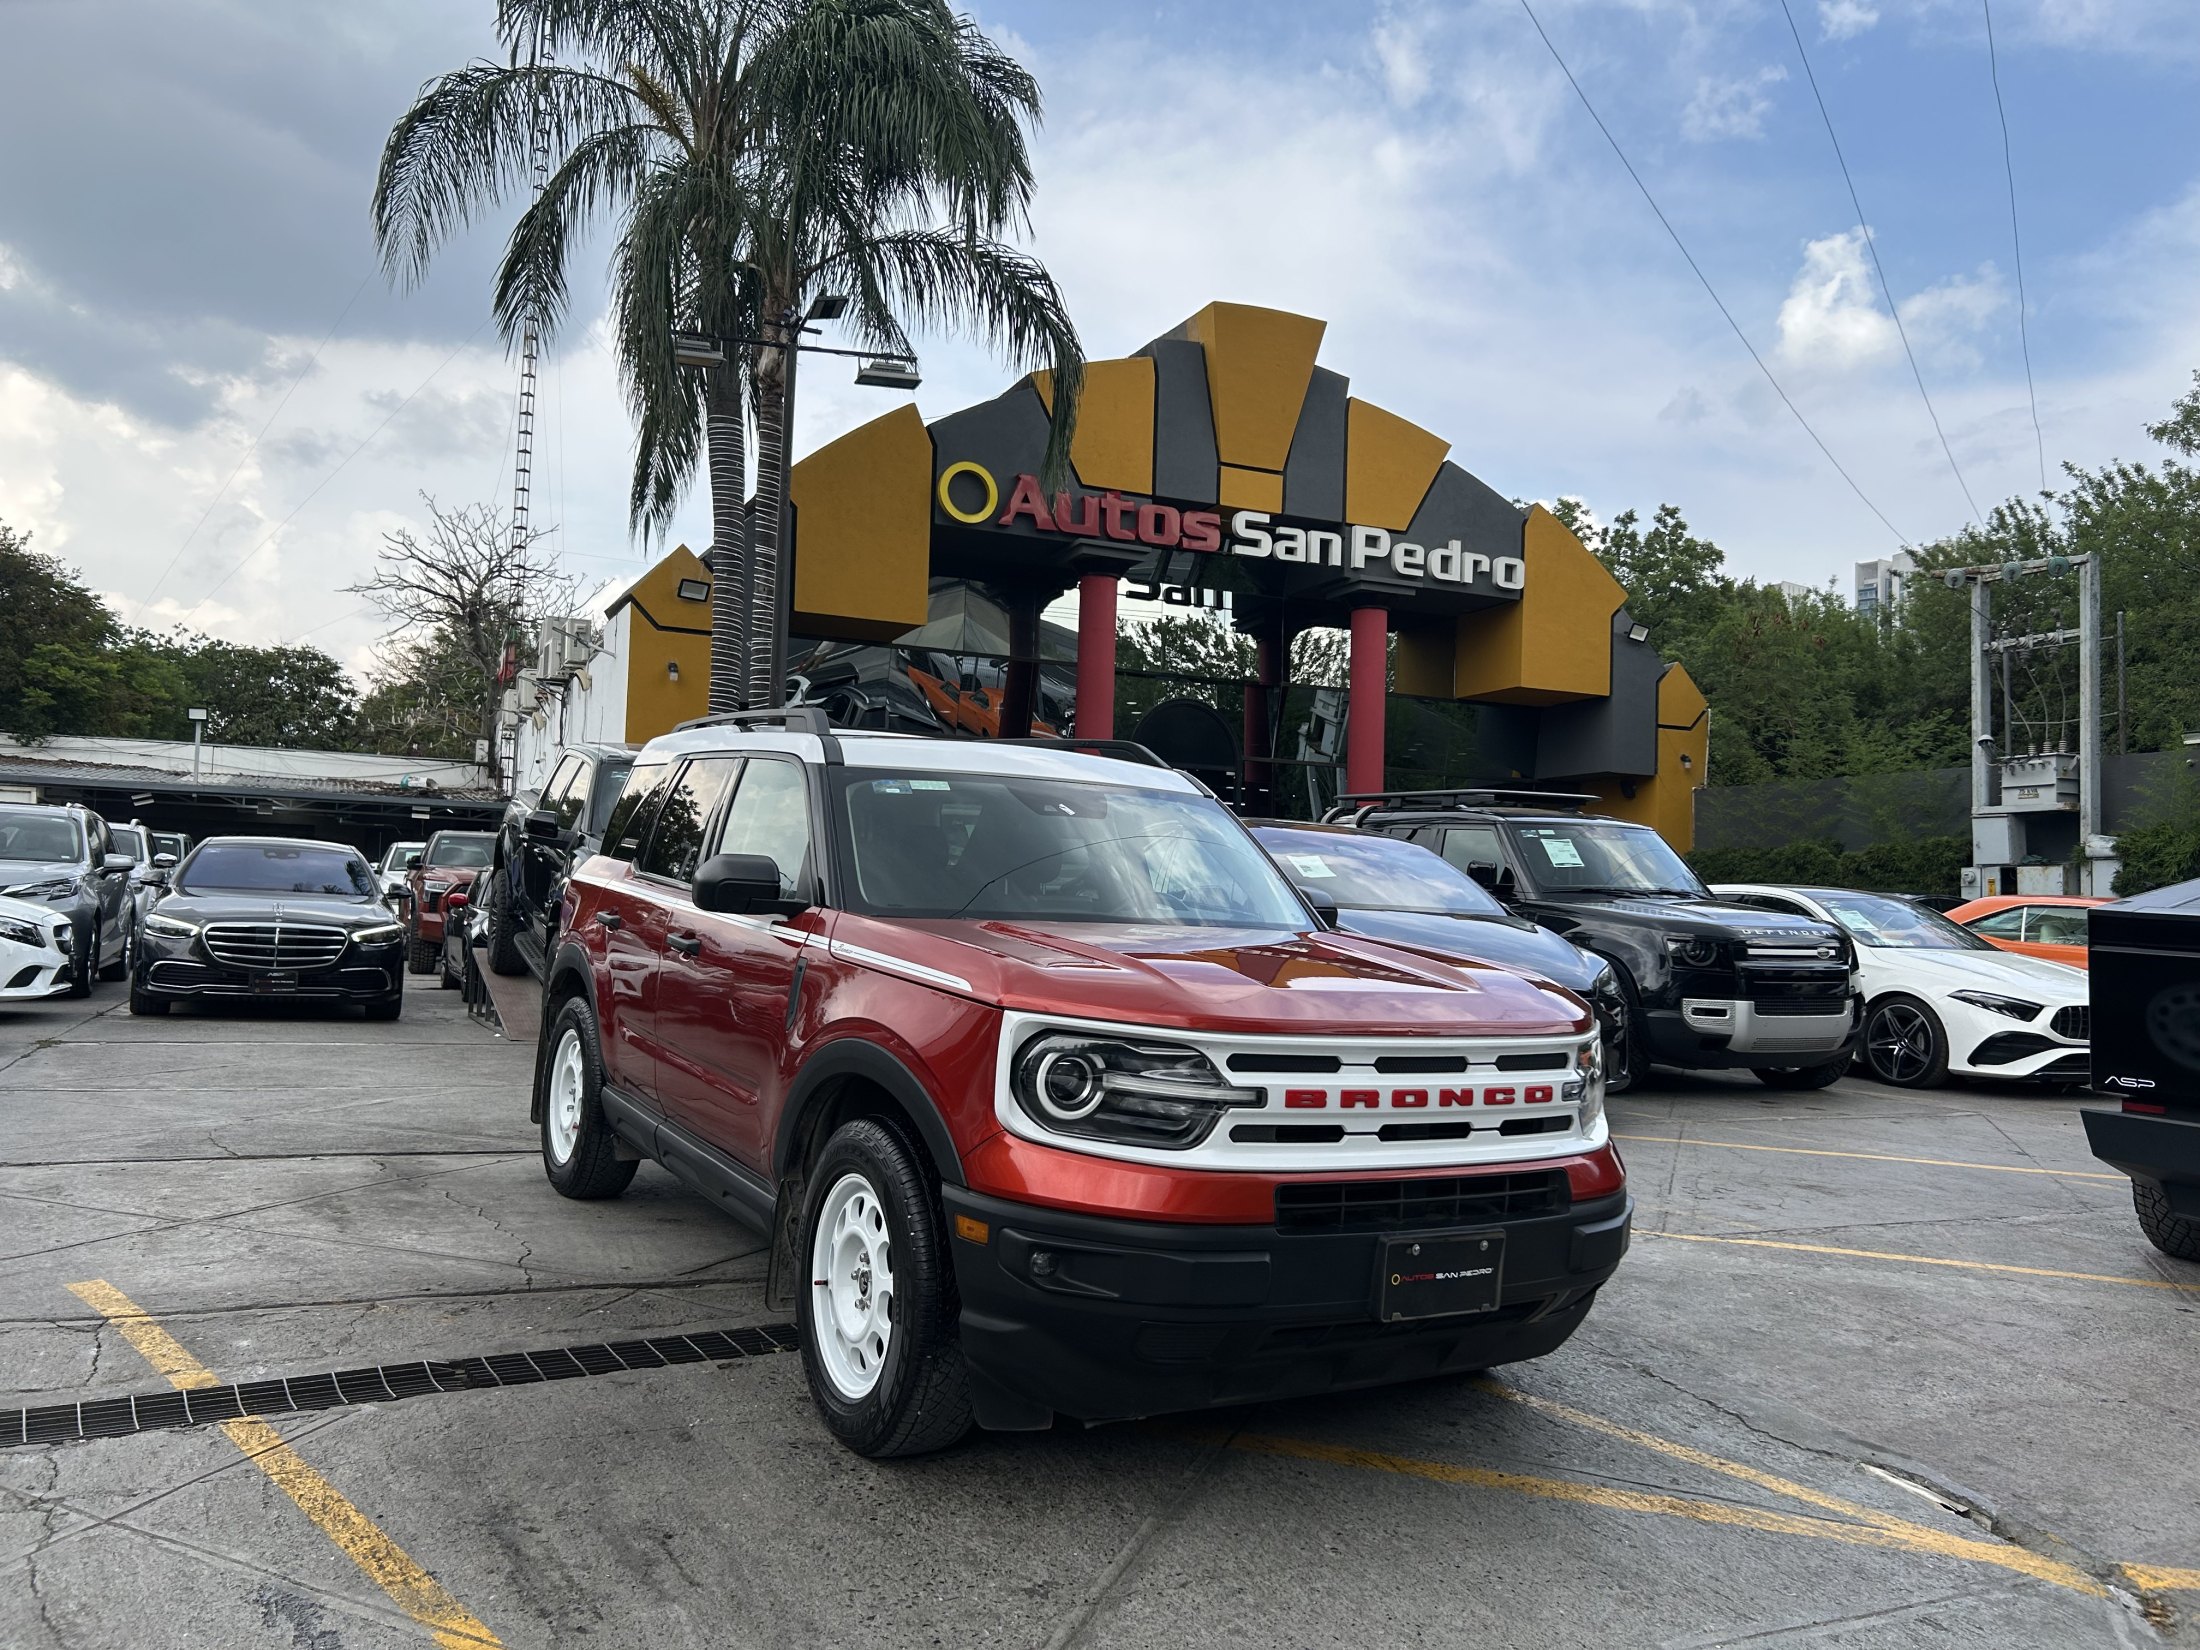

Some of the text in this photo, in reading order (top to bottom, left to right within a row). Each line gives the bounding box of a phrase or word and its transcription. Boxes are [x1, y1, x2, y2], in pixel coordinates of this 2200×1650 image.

[998, 473, 1221, 552] Autos
[2104, 1076, 2156, 1088] ASP
[1284, 1085, 1553, 1109] BRONCO
[1401, 1267, 1493, 1282] AUTOS SAN PEDRO
